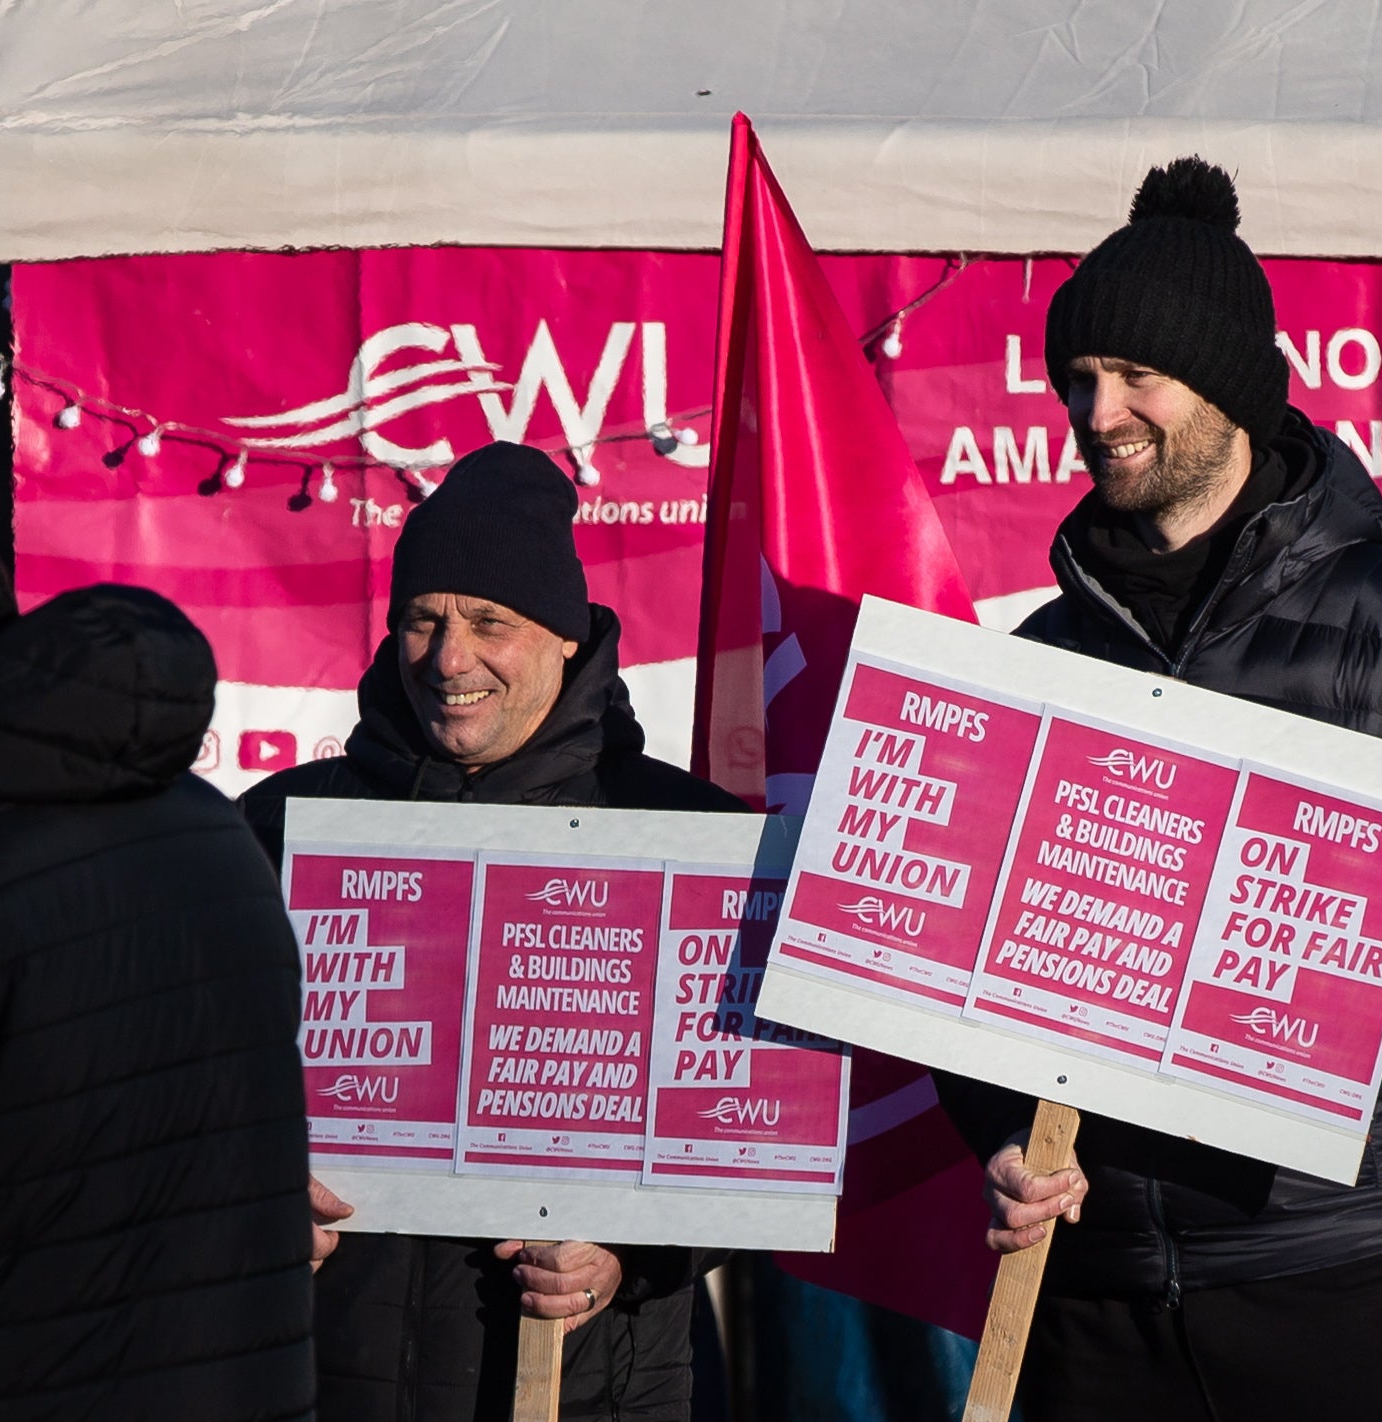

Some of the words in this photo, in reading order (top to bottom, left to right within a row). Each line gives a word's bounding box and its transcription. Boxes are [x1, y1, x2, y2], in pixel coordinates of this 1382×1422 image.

[939, 425, 1089, 485] AMA
[349, 498, 404, 528] The
[659, 496, 708, 525] uni
[900, 691, 989, 743] RMPFS
[854, 728, 916, 769] I'M
[1086, 748, 1177, 790] CWU
[848, 766, 947, 815] WITH
[837, 804, 902, 843] MY
[1054, 779, 1101, 816] PFSL
[1103, 794, 1206, 845] CLEANERS
[1292, 801, 1382, 854] RMPFS
[1055, 813, 1074, 841] &
[1074, 818, 1188, 872] BUILDINGS
[1240, 837, 1301, 876] ON
[340, 868, 424, 902] RMPFS
[831, 841, 961, 898] UNION
[1036, 840, 1190, 906] MAINTENANCE
[524, 878, 609, 908] CWU
[721, 889, 784, 921] RMP
[1229, 874, 1358, 930] STRIKE
[304, 914, 360, 945] I'M
[836, 897, 926, 937] CWU
[1020, 877, 1063, 911] WE
[1057, 889, 1165, 941] DEMAND
[1160, 921, 1184, 949] A
[502, 922, 546, 949] PFSL
[548, 924, 645, 953] CLEANERS
[678, 934, 732, 966] ON
[1013, 910, 1071, 949] FAIR
[1068, 926, 1123, 962] PAY
[1115, 942, 1174, 978] AND
[1220, 911, 1296, 956] FOR
[306, 952, 397, 983] WITH
[508, 954, 525, 979] &
[527, 955, 633, 984] BUILDINGS
[995, 939, 1117, 1001] PENSIONS
[1112, 974, 1173, 1014] DEAL
[1212, 949, 1292, 992] PAY
[303, 990, 361, 1022] MY
[496, 985, 641, 1016] MAINTENANCE
[675, 972, 763, 1004] STRI
[303, 1027, 424, 1059] UNION
[488, 1024, 524, 1051] WE
[524, 1026, 624, 1056] DEMAND
[623, 1031, 642, 1057] A
[675, 1011, 744, 1043] FOR
[1228, 1006, 1319, 1049] CWU
[487, 1056, 540, 1085] FAIR
[540, 1059, 589, 1087] PAY
[585, 1062, 639, 1089] AND
[673, 1049, 745, 1081] PAY
[316, 1074, 399, 1104] CWU
[476, 1088, 589, 1120] PENSIONS
[588, 1095, 643, 1123] DEAL
[697, 1096, 781, 1126] CWU
